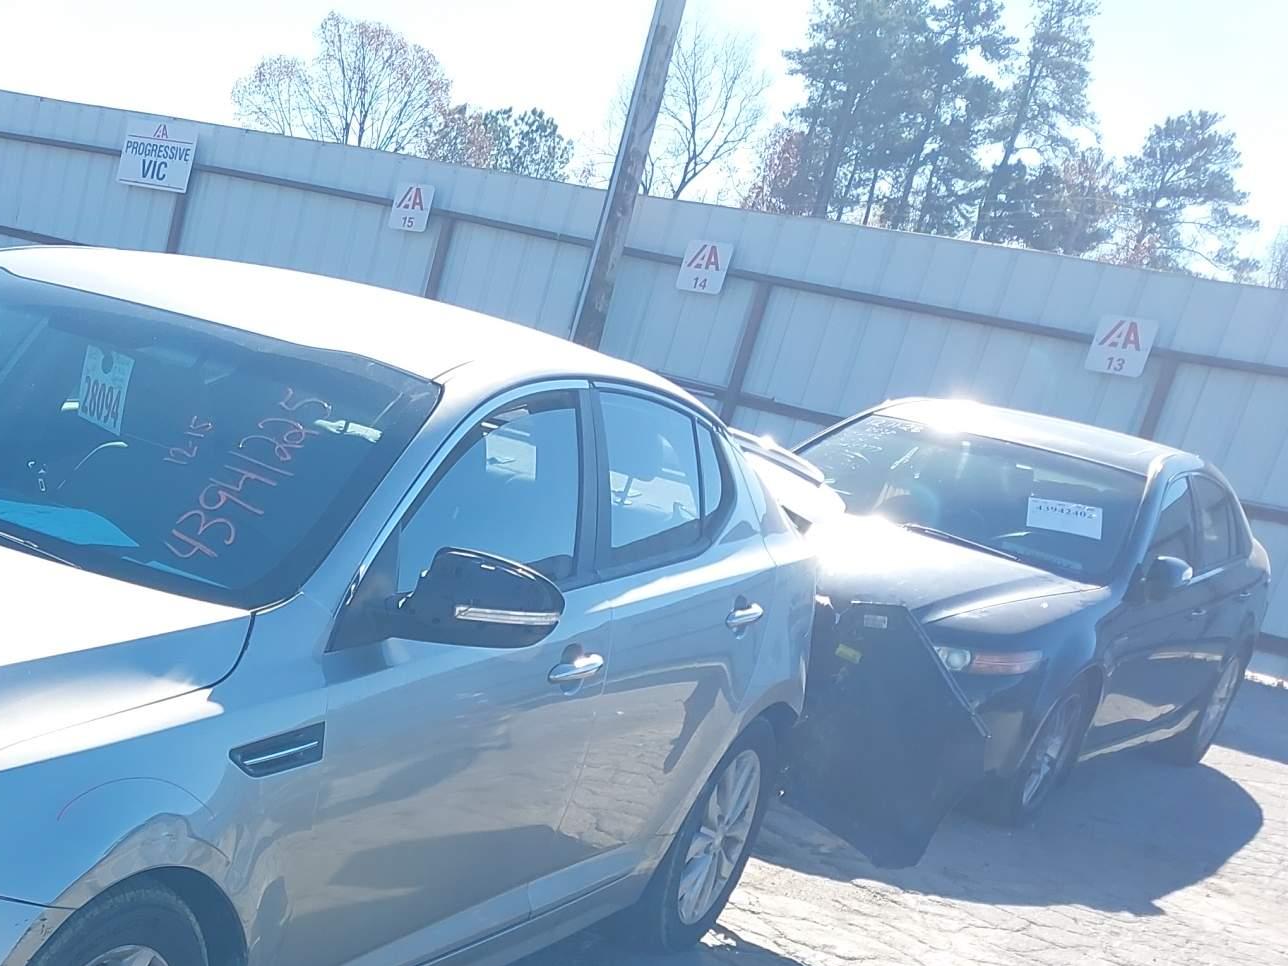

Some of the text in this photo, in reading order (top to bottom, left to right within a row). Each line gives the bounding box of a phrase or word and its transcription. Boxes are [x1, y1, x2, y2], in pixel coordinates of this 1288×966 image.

[124, 139, 191, 162] PROGRESSIVE
[142, 158, 168, 181] VIC
[401, 215, 415, 228] 15
[693, 276, 708, 290] 14
[1107, 356, 1126, 372] 13
[81, 375, 123, 429] 28094
[162, 415, 213, 465] 12-15
[164, 388, 333, 558] 43941225
